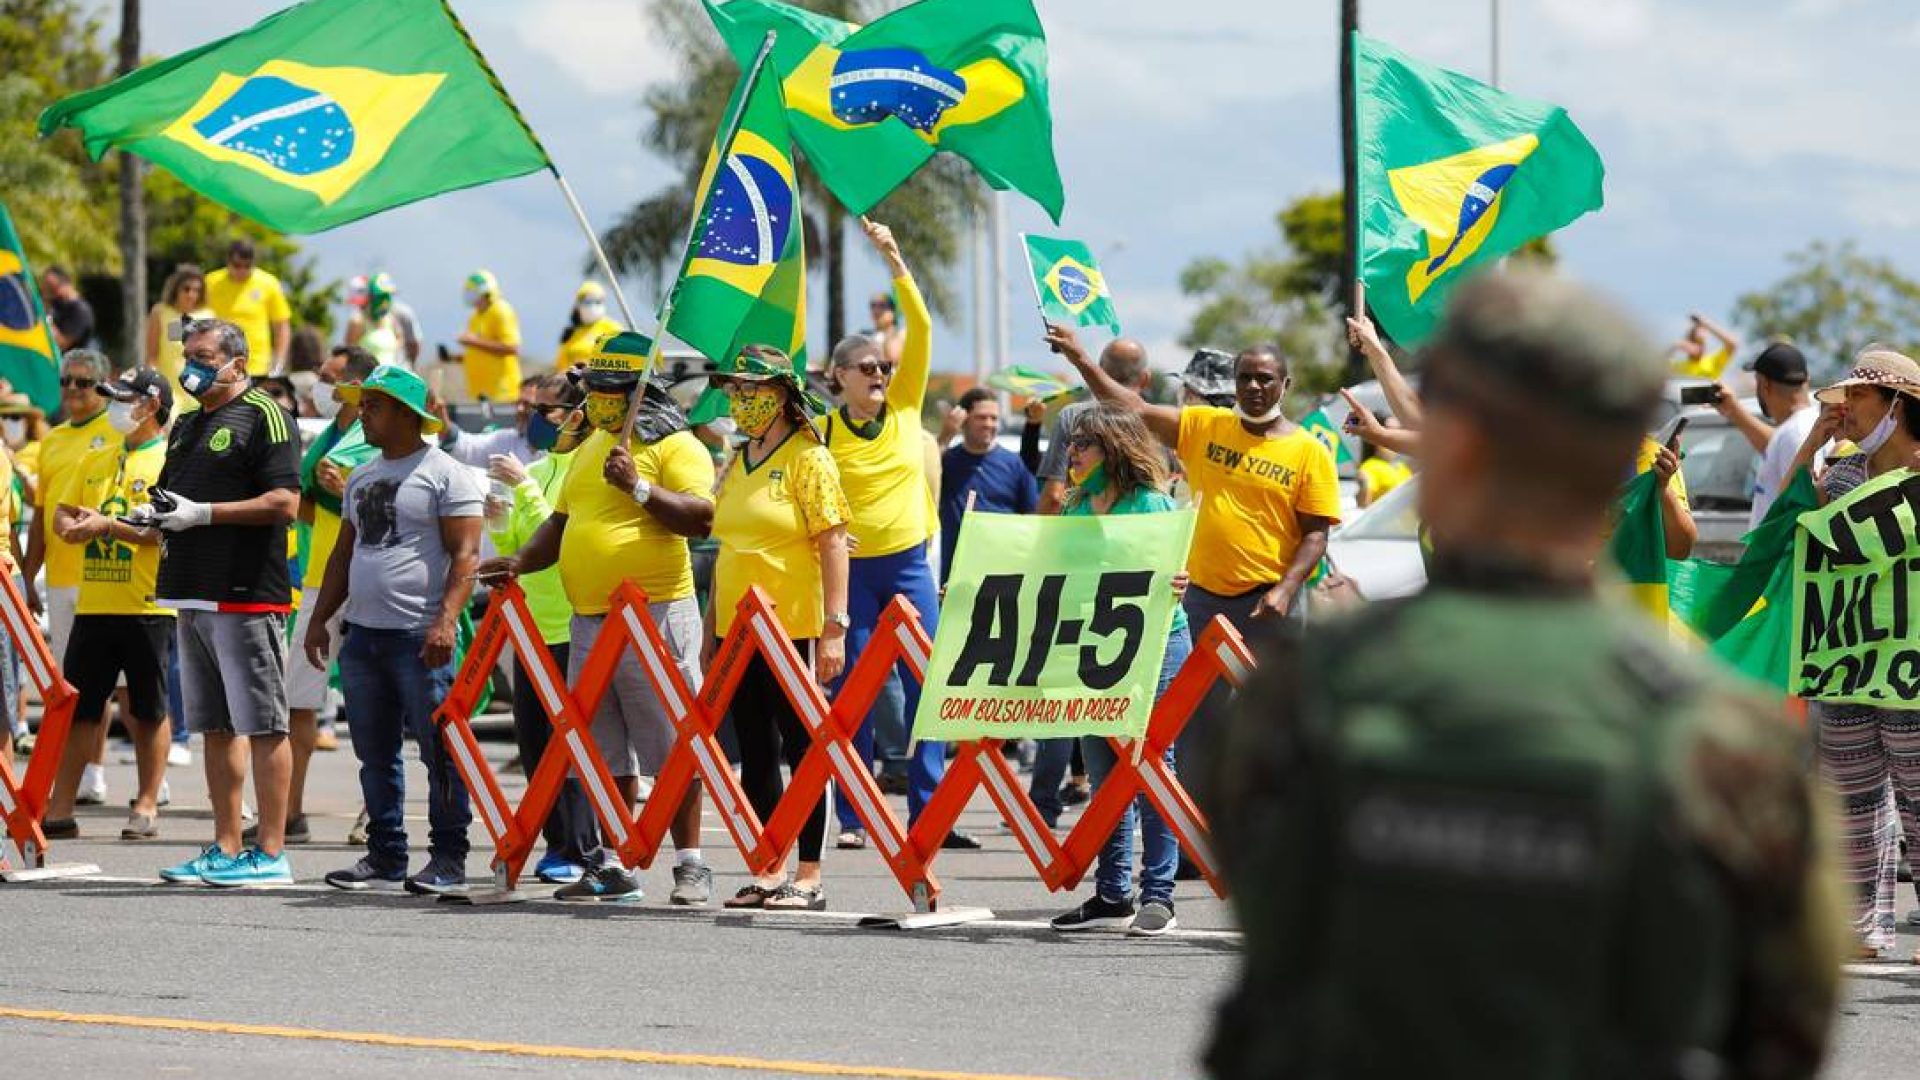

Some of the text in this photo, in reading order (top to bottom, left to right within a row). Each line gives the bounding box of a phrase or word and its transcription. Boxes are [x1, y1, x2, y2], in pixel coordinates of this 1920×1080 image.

[1207, 441, 1297, 487] NEW YORK
[946, 571, 1156, 690] AI-5
[940, 697, 1130, 723] COM BOLSONARO NO PODER
